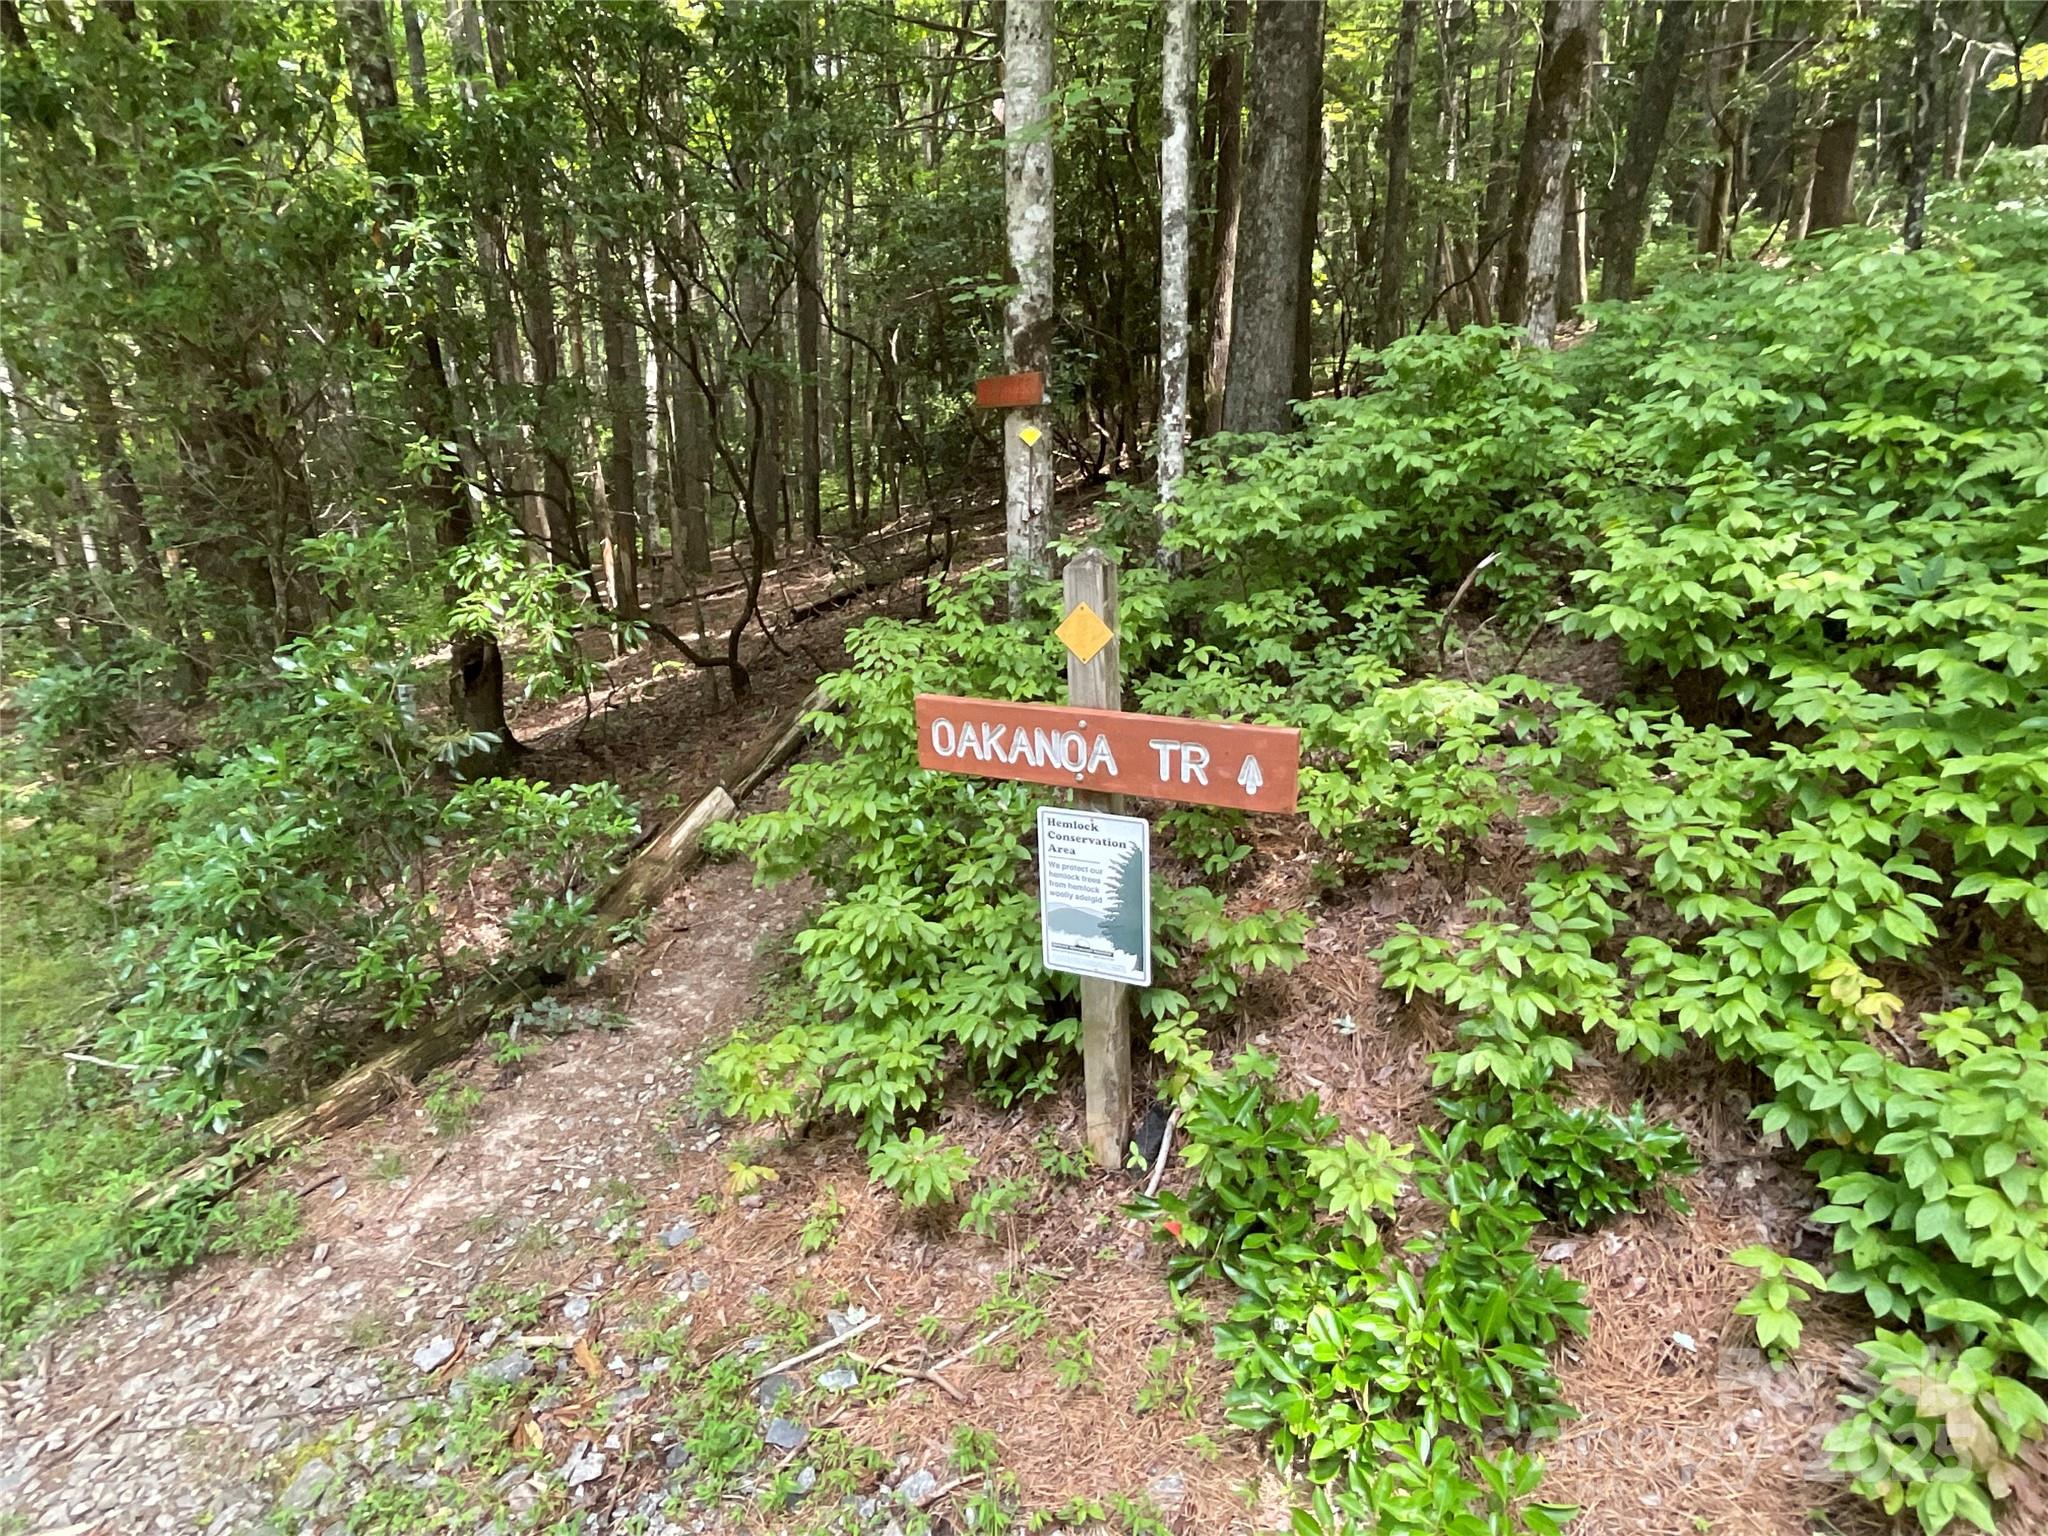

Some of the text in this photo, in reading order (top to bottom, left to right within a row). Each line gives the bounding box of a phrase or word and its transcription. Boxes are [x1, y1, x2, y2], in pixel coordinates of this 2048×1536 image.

[931, 717, 1210, 786] OAKANOA TR
[1047, 817, 1099, 833] Hemlock
[1047, 830, 1127, 849] Conservation
[1047, 844, 1076, 855] Area
[1048, 860, 1060, 869] We
